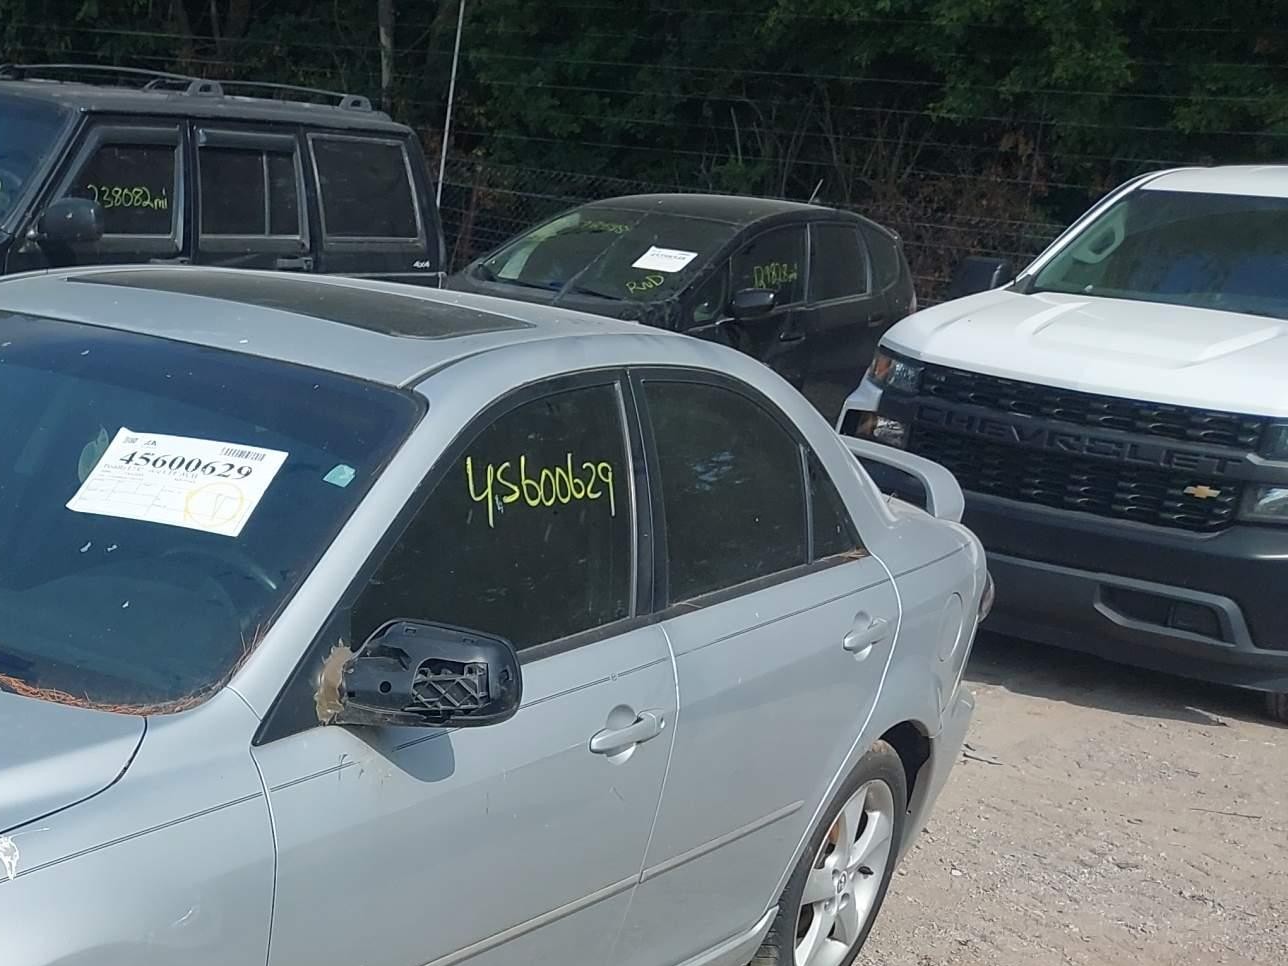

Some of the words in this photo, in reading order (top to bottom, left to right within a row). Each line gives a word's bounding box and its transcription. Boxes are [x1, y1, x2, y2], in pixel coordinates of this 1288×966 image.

[119, 449, 254, 481] 45600629
[913, 402, 1245, 476] CHEVROLET
[466, 452, 616, 528] 45600629
